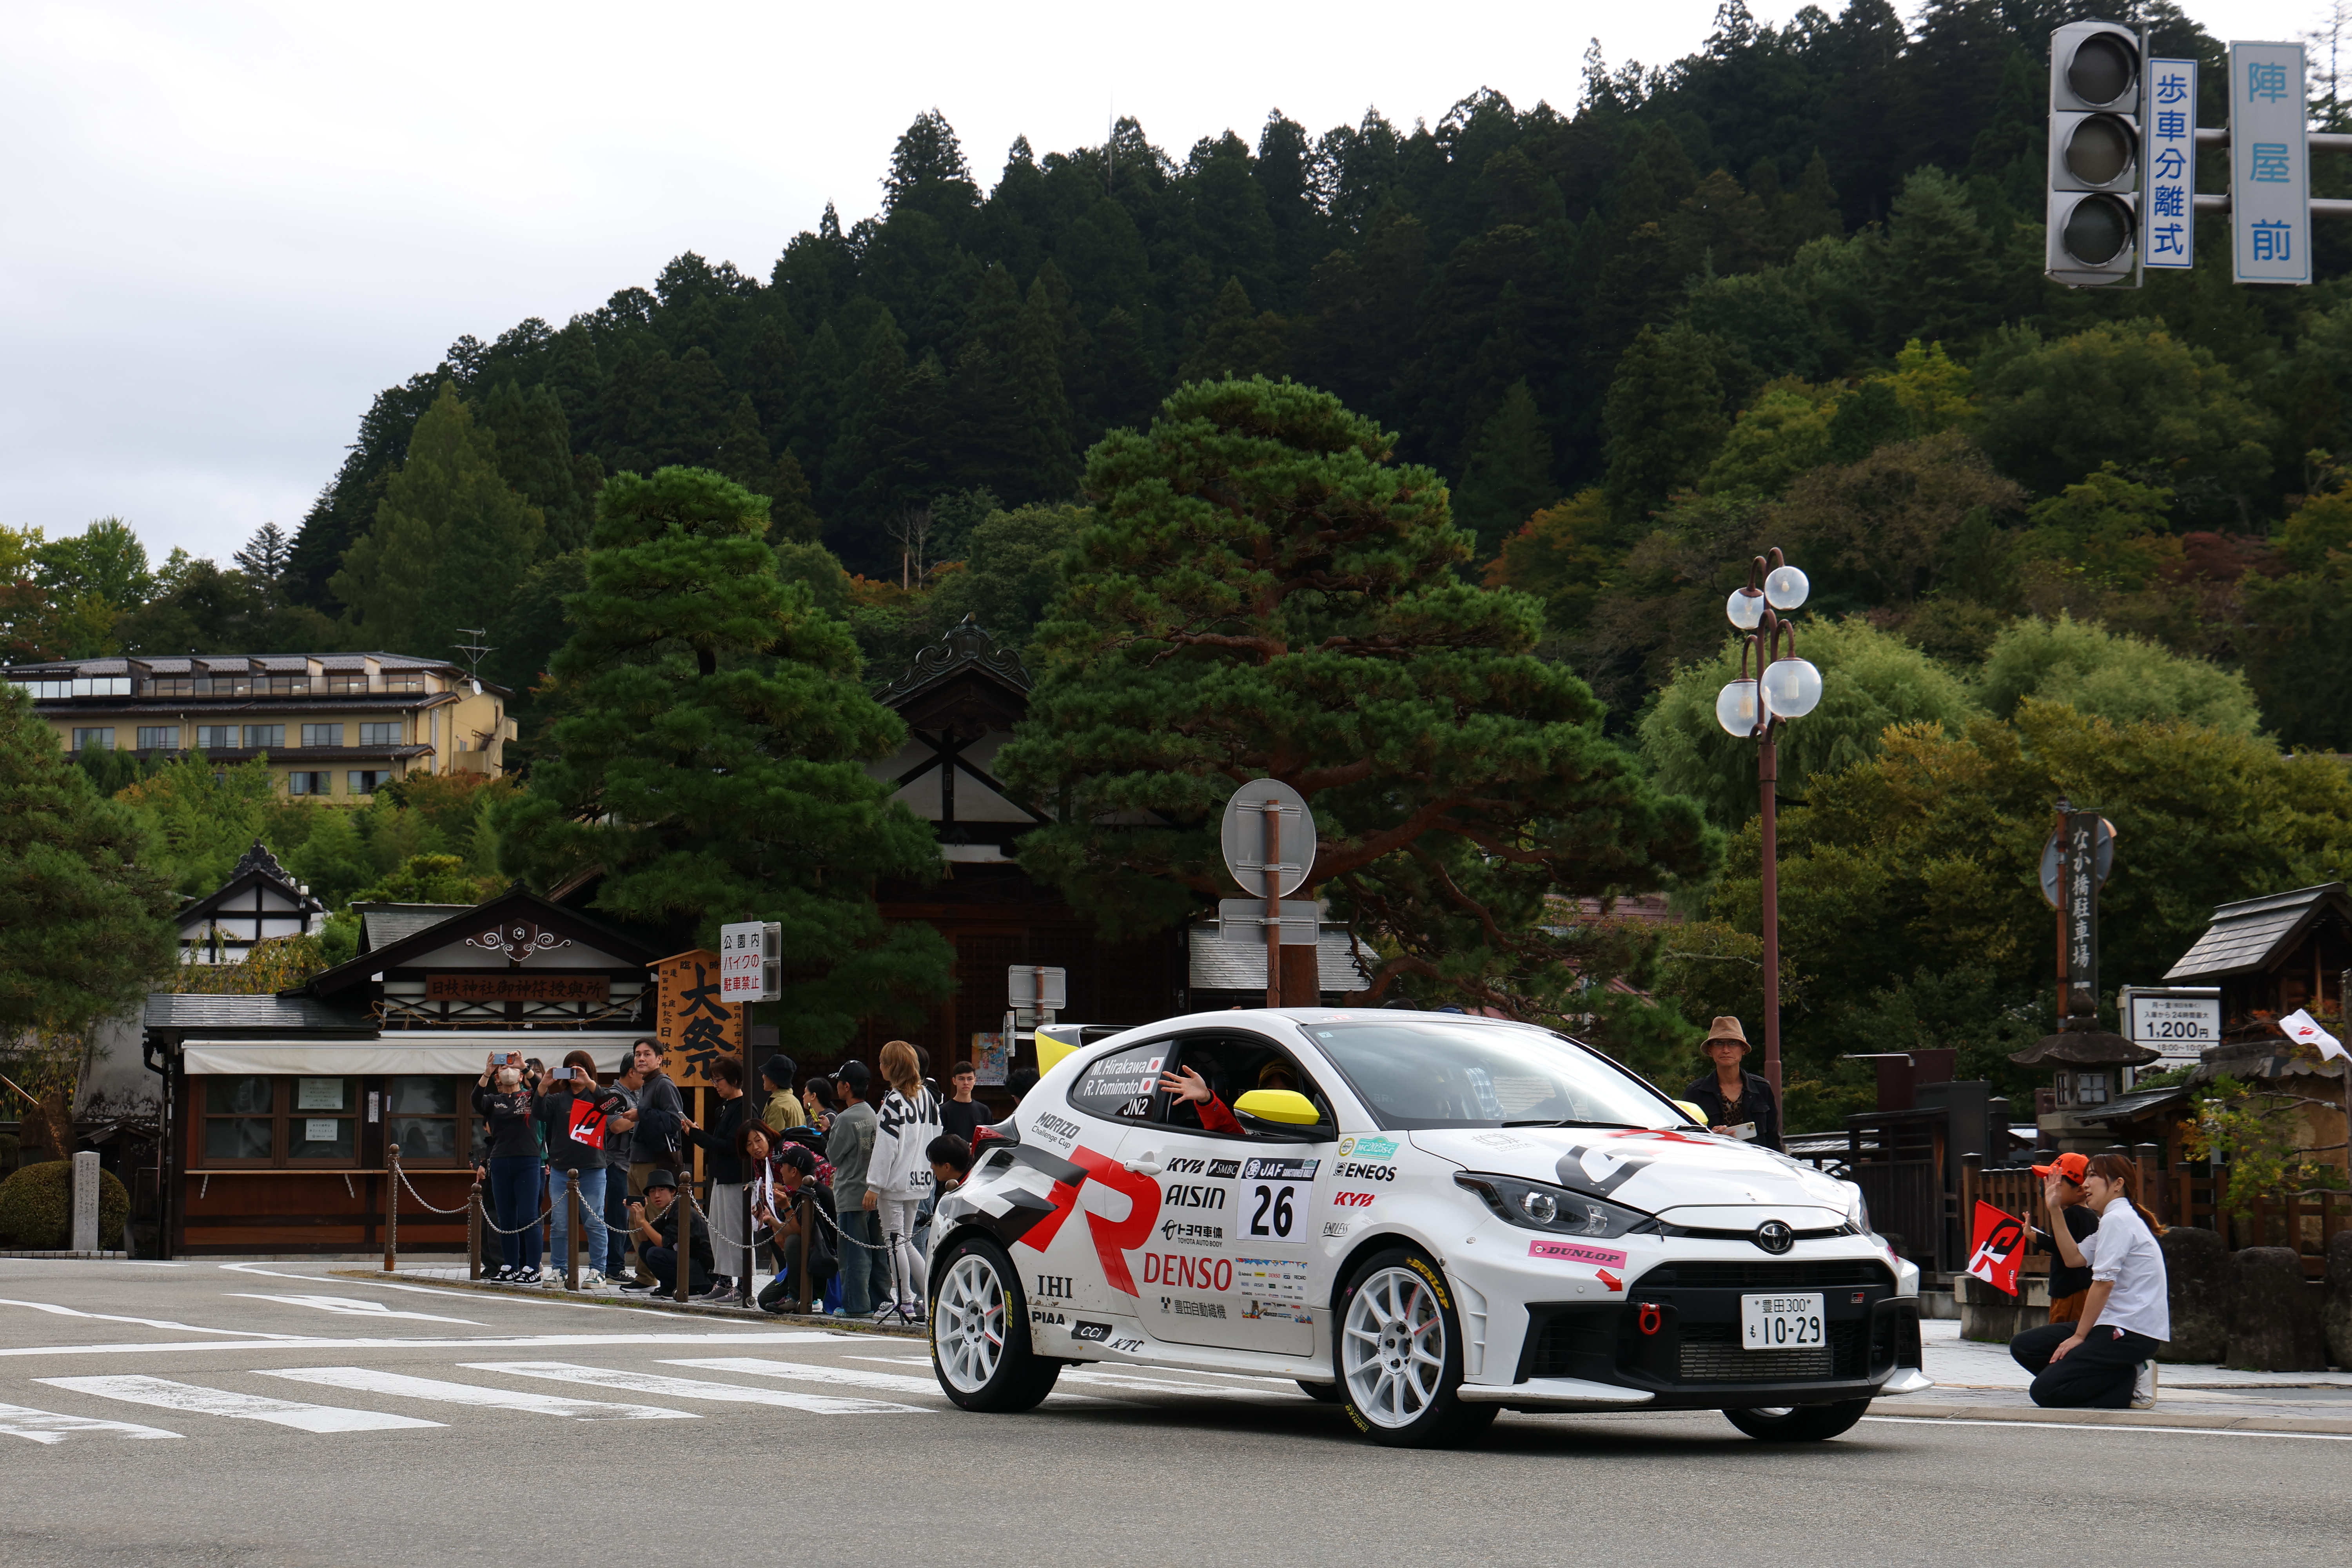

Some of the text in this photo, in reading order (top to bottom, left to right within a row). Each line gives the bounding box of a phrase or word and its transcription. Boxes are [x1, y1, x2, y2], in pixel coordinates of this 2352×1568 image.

[2154, 73, 2188, 256] 歩車分離式
[2249, 62, 2291, 261] 陣屋前
[2072, 826, 2092, 968] なか橋駐車場
[724, 932, 759, 949] 公園内
[724, 954, 759, 971] バイクの
[723, 975, 760, 992] 駐車禁止
[674, 962, 736, 1081] 大祭
[2146, 1021, 2209, 1038] 1,200円
[1091, 1058, 1147, 1076] M.Hirakawa
[1083, 1078, 1139, 1096] R.Tomimoto
[1123, 1098, 1149, 1116] JN2
[1035, 1111, 1081, 1140] MORIZO
[1031, 1125, 1071, 1150] Challenge Cup
[1493, 1142, 1532, 1151] TOYOTA
[1166, 1157, 1239, 1175] KYB SMBC
[1260, 1163, 1284, 1177] JAF
[1345, 1163, 1397, 1182] ENEOS
[1165, 1184, 1226, 1209] AISIN
[1333, 1191, 1376, 1207] KYB
[1250, 1185, 1295, 1238] 26
[1177, 1223, 1223, 1239] トヨタ車体
[1323, 1222, 1350, 1234] ENDLESS
[1546, 1246, 1620, 1263] DUNLOP
[1143, 1252, 1232, 1292] DENSO
[1037, 1275, 1073, 1298] IHI
[1410, 1258, 1450, 1309] DUNLOP
[1031, 1311, 1065, 1325] PIAA
[1174, 1299, 1227, 1319] 豊田自動織機
[1764, 1316, 1820, 1344] 10-29
[1108, 1338, 1145, 1352] KTC
